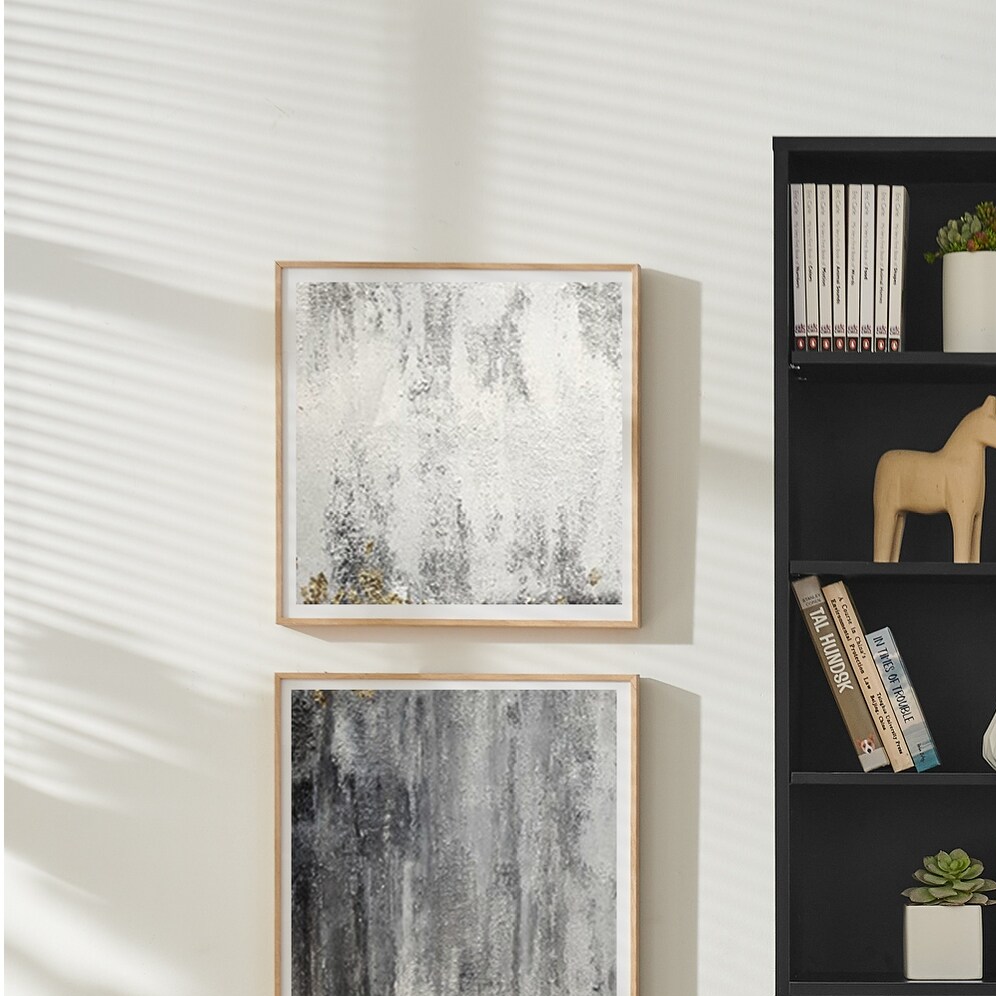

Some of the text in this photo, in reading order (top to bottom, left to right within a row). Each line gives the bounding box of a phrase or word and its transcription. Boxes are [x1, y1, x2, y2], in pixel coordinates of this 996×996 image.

[809, 606, 854, 694] TAL HUNDSK
[830, 598, 871, 690] Environmental Protection Law
[841, 604, 852, 625] Course
[850, 626, 856, 634] in
[854, 636, 866, 659] China's
[872, 635, 915, 724] IN TIMES OF TROUBLE
[876, 691, 903, 755] Tsinghua University Press
[878, 715, 887, 731] China
